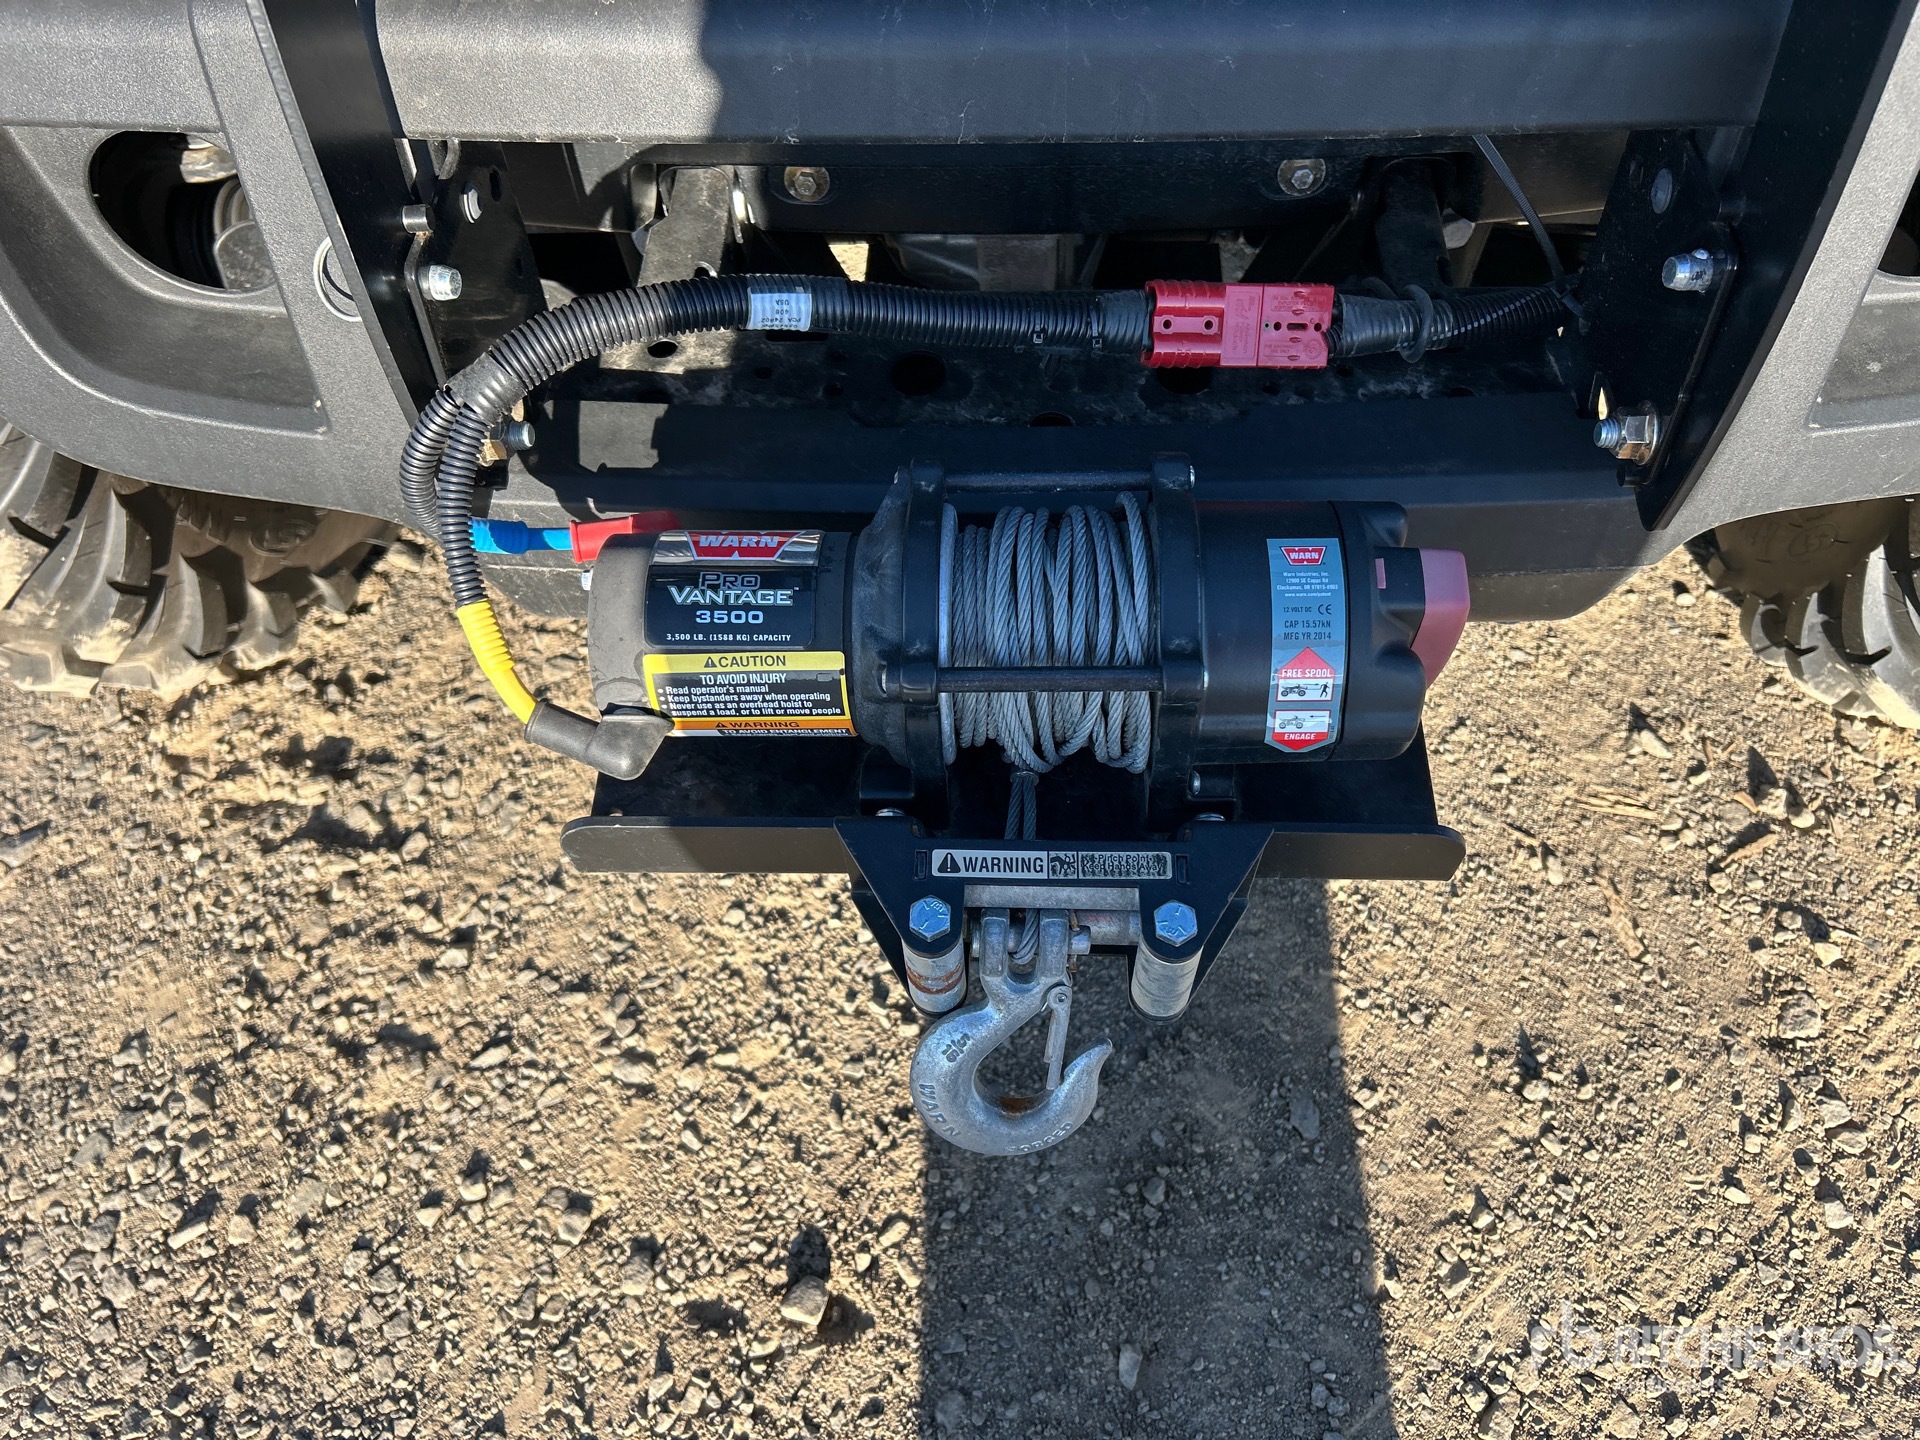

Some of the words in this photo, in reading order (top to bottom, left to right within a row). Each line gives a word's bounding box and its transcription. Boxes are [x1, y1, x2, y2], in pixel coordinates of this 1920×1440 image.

[699, 535, 780, 548] WARN
[1289, 551, 1319, 559] WARN
[695, 610, 764, 624] 3500
[1284, 620, 1299, 628] CAP
[1301, 620, 1331, 628] 15.57kN
[666, 633, 691, 642] 3,500
[693, 633, 707, 641] LB.
[709, 633, 734, 642] (1588
[736, 633, 750, 642] KG)
[753, 633, 791, 642] CAPACITY
[1283, 632, 1299, 640] MFG
[1301, 632, 1311, 640] YR
[1313, 632, 1331, 640] 2014
[718, 655, 787, 668] CAUTION
[1281, 668, 1303, 678] FREE
[1304, 668, 1332, 678] SPOOL
[700, 675, 715, 685] TO
[716, 674, 748, 685] AVOID
[750, 673, 787, 684] INJURY
[665, 686, 689, 695] Read
[691, 685, 735, 697] operator's
[736, 684, 769, 693] manual
[667, 694, 690, 704] Keep
[691, 693, 738, 704] bystanders
[740, 694, 764, 703] away
[765, 693, 788, 701] when
[790, 692, 831, 703] operating
[739, 701, 780, 709] overhead
[781, 700, 803, 708] hoist
[804, 700, 812, 708] to
[671, 709, 708, 717] suspend
[762, 707, 774, 715] lift
[812, 707, 841, 716] people
[1284, 732, 1316, 740] ENGAGE
[963, 856, 1044, 873] WARNING
[919, 1082, 961, 1138] WARN
